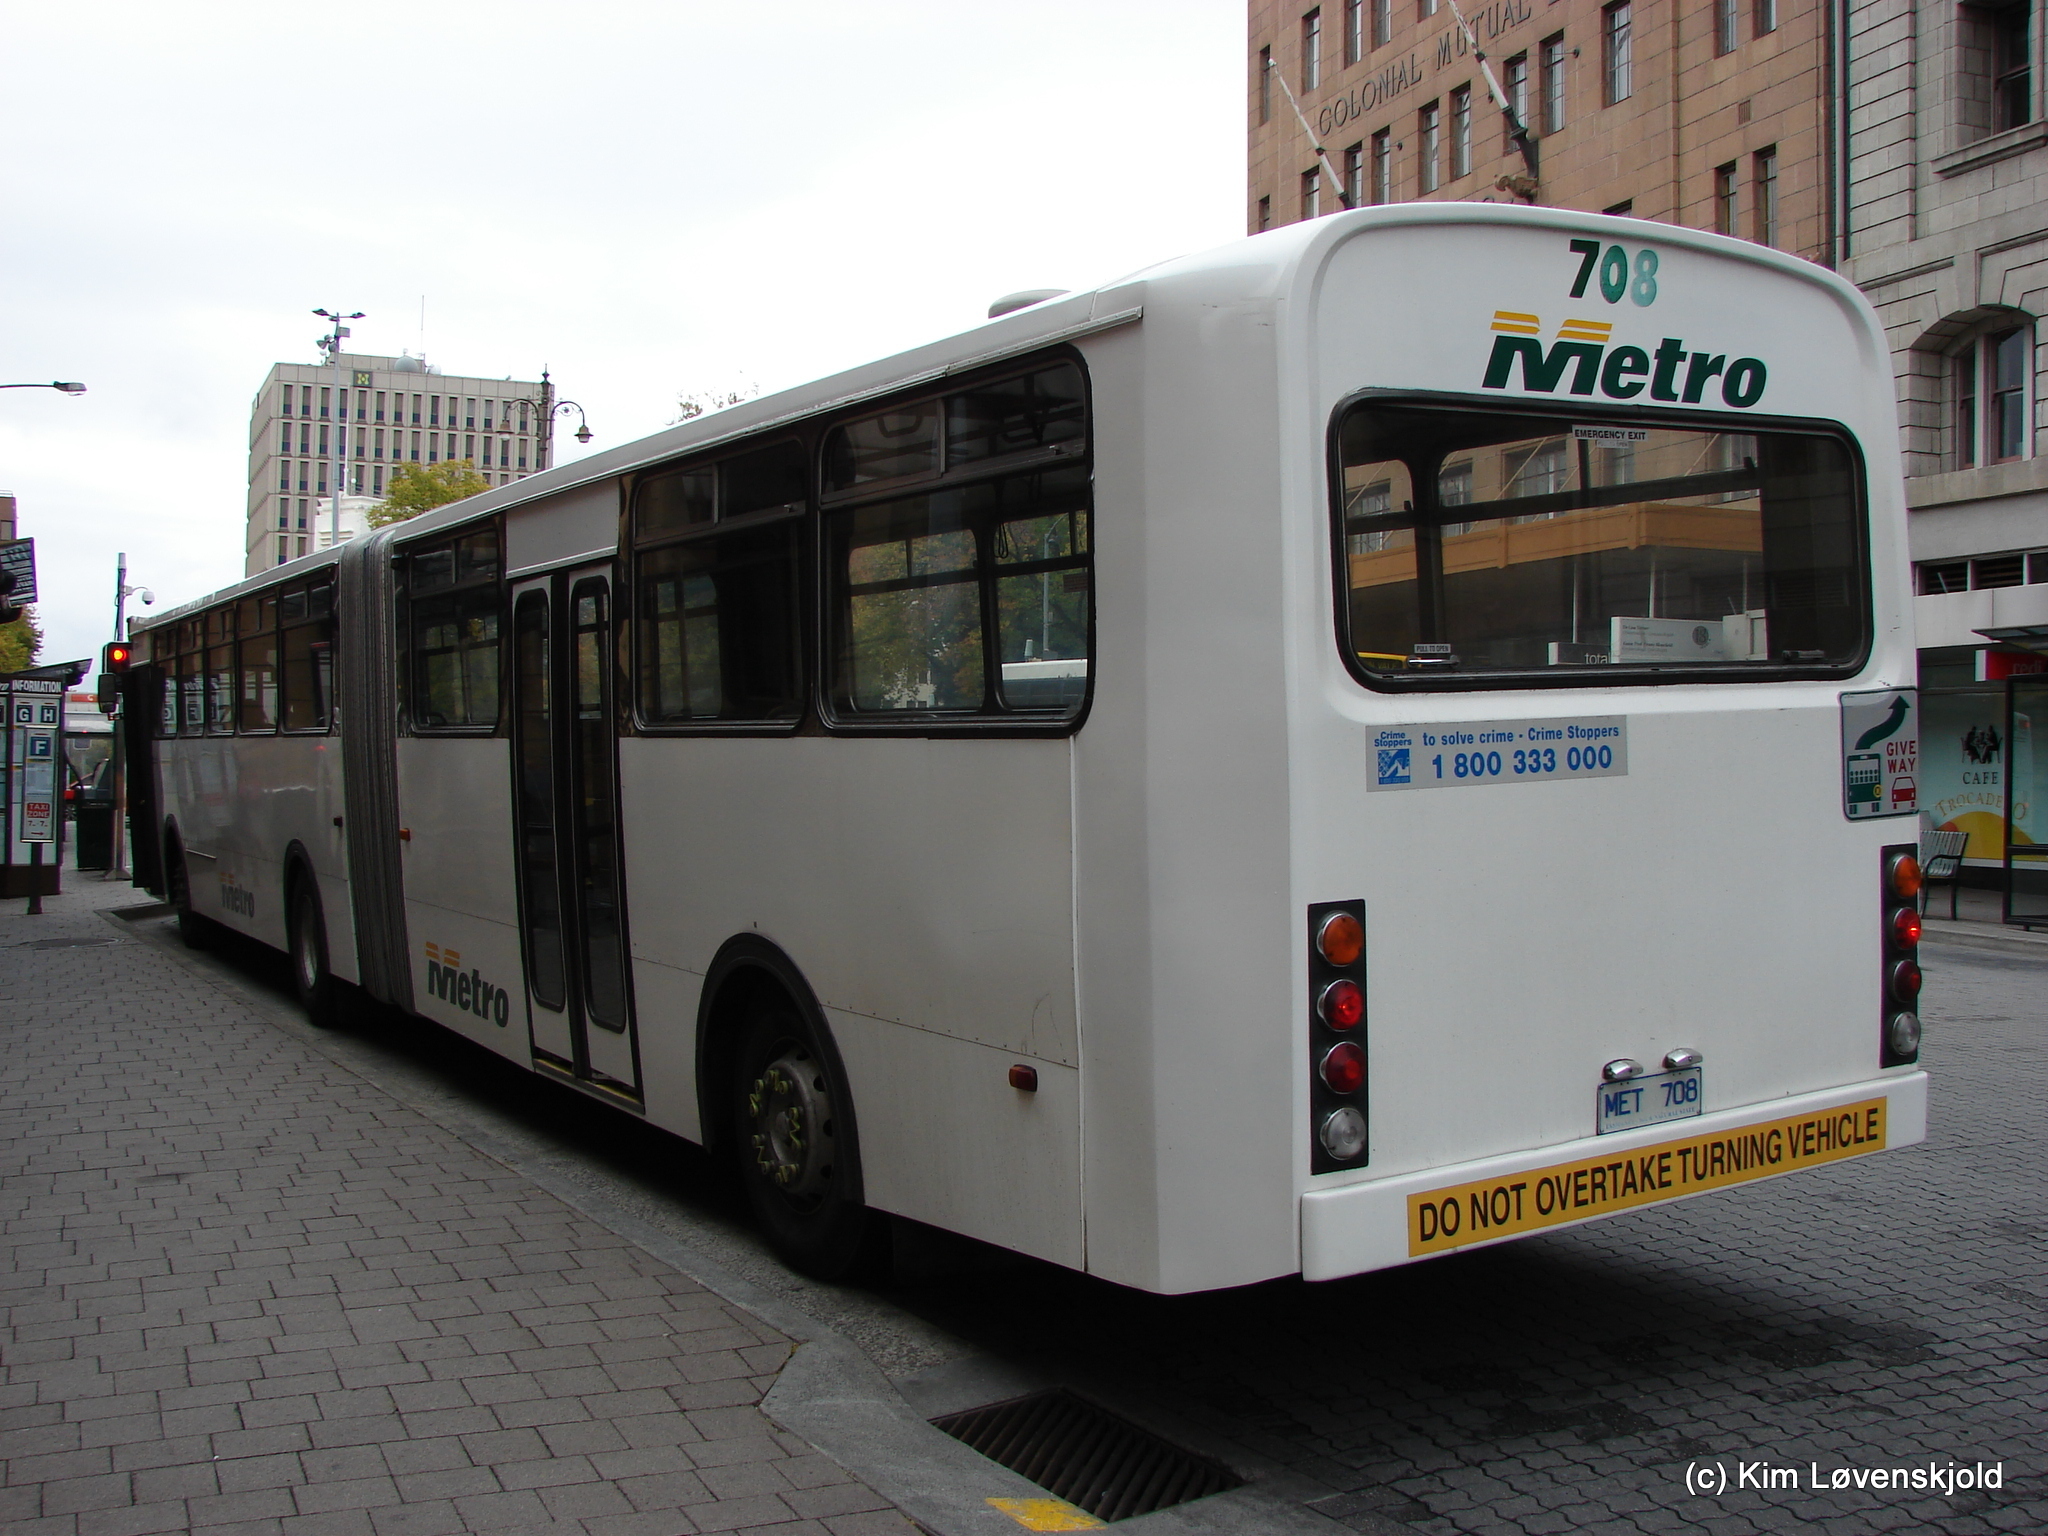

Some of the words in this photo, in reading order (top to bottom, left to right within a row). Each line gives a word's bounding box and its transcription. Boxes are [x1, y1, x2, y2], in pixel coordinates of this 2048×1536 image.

[1319, 53, 1422, 136] COLONIAL
[1436, 0, 1532, 71] MUTUAL
[1569, 239, 1659, 307] 708
[1481, 333, 1768, 408] Metro
[1574, 429, 1625, 439] EMERGENCY
[1628, 431, 1646, 440] EXIT
[12, 680, 61, 693] INFORMATION
[19, 708, 30, 721] G
[43, 709, 54, 721] H
[1374, 739, 1412, 748] Stoppers
[1380, 731, 1406, 740] Crime
[1423, 732, 1436, 746] to
[1441, 731, 1474, 745] solve
[1479, 729, 1514, 744] crime
[1528, 727, 1563, 741] Crime
[1567, 724, 1620, 741] Stoppers
[35, 741, 47, 754] F
[1886, 740, 1916, 756] GIVE
[1432, 754, 1442, 778] 1
[1454, 751, 1501, 778] 800
[1513, 748, 1556, 775] 333
[1567, 745, 1612, 771] 000
[1887, 758, 1916, 773] WAY
[1962, 771, 1998, 785] CAFE
[1935, 792, 2027, 819] TROCADEO
[221, 883, 255, 918] Metro
[427, 959, 509, 1028] Metro
[1605, 1087, 1644, 1118] MET
[1660, 1078, 1697, 1107] 708
[1419, 1197, 1460, 1242] DO
[1470, 1184, 1527, 1231] NOT
[1535, 1152, 1672, 1216] OVERTAKE
[1677, 1128, 1782, 1184] TURNING
[1787, 1107, 1879, 1158] VEHICLE
